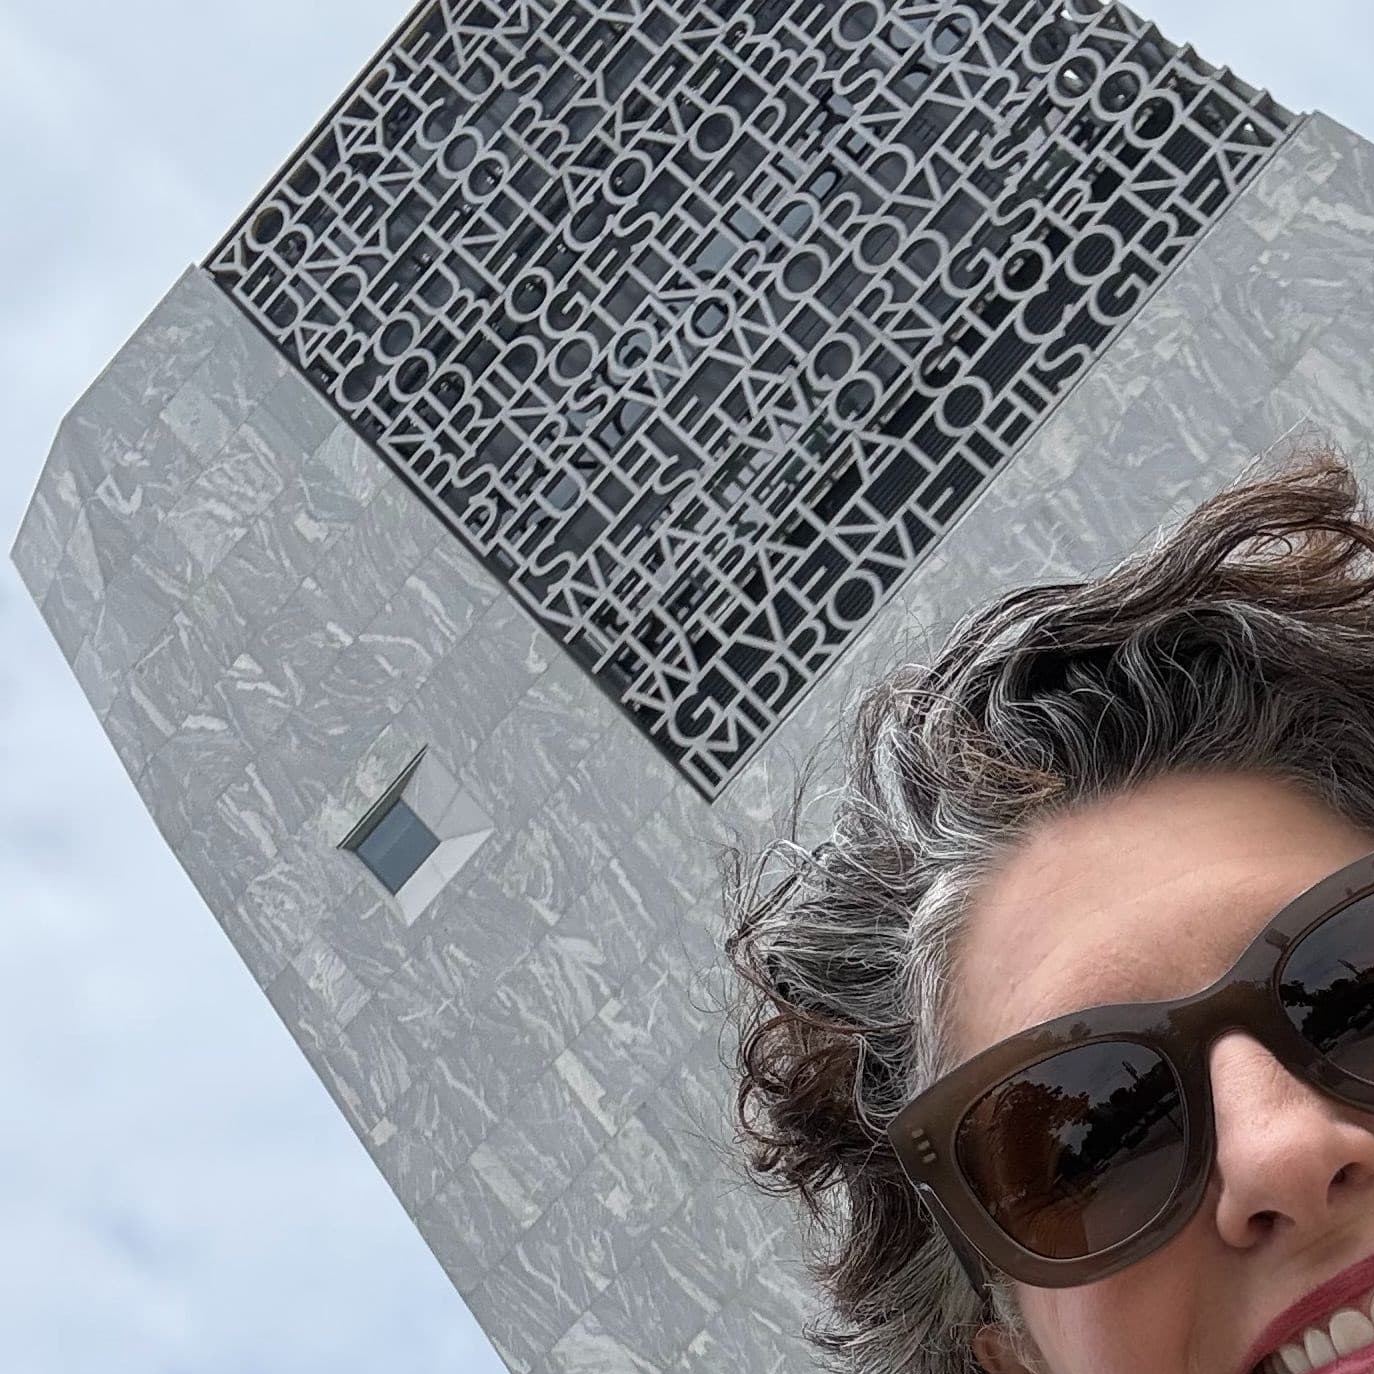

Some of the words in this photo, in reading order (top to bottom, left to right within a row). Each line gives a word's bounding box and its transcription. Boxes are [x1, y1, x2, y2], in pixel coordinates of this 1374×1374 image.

[209, 149, 322, 275] YOU
[329, 19, 441, 159] ARE
[313, 116, 390, 216] BY
[336, 68, 613, 409] COUNTRY
[398, 126, 481, 208] TO
[416, 102, 555, 252] FOR
[609, 158, 745, 294] THE
[401, 202, 655, 498] BRIDGES
[648, 102, 738, 187] TO
[454, 260, 709, 554] PERSON
[696, 115, 832, 249] THE
[463, 265, 551, 352] TO
[570, 380, 710, 524] THE
[703, 139, 913, 363] WORD
[617, 189, 818, 404] WORD
[734, 227, 947, 452] WORD
[536, 508, 654, 626] WE
[668, 491, 891, 745] GIVEN
[887, 374, 990, 471] TO
[680, 470, 970, 797] IMPROVE
[942, 334, 1089, 475] THIS
